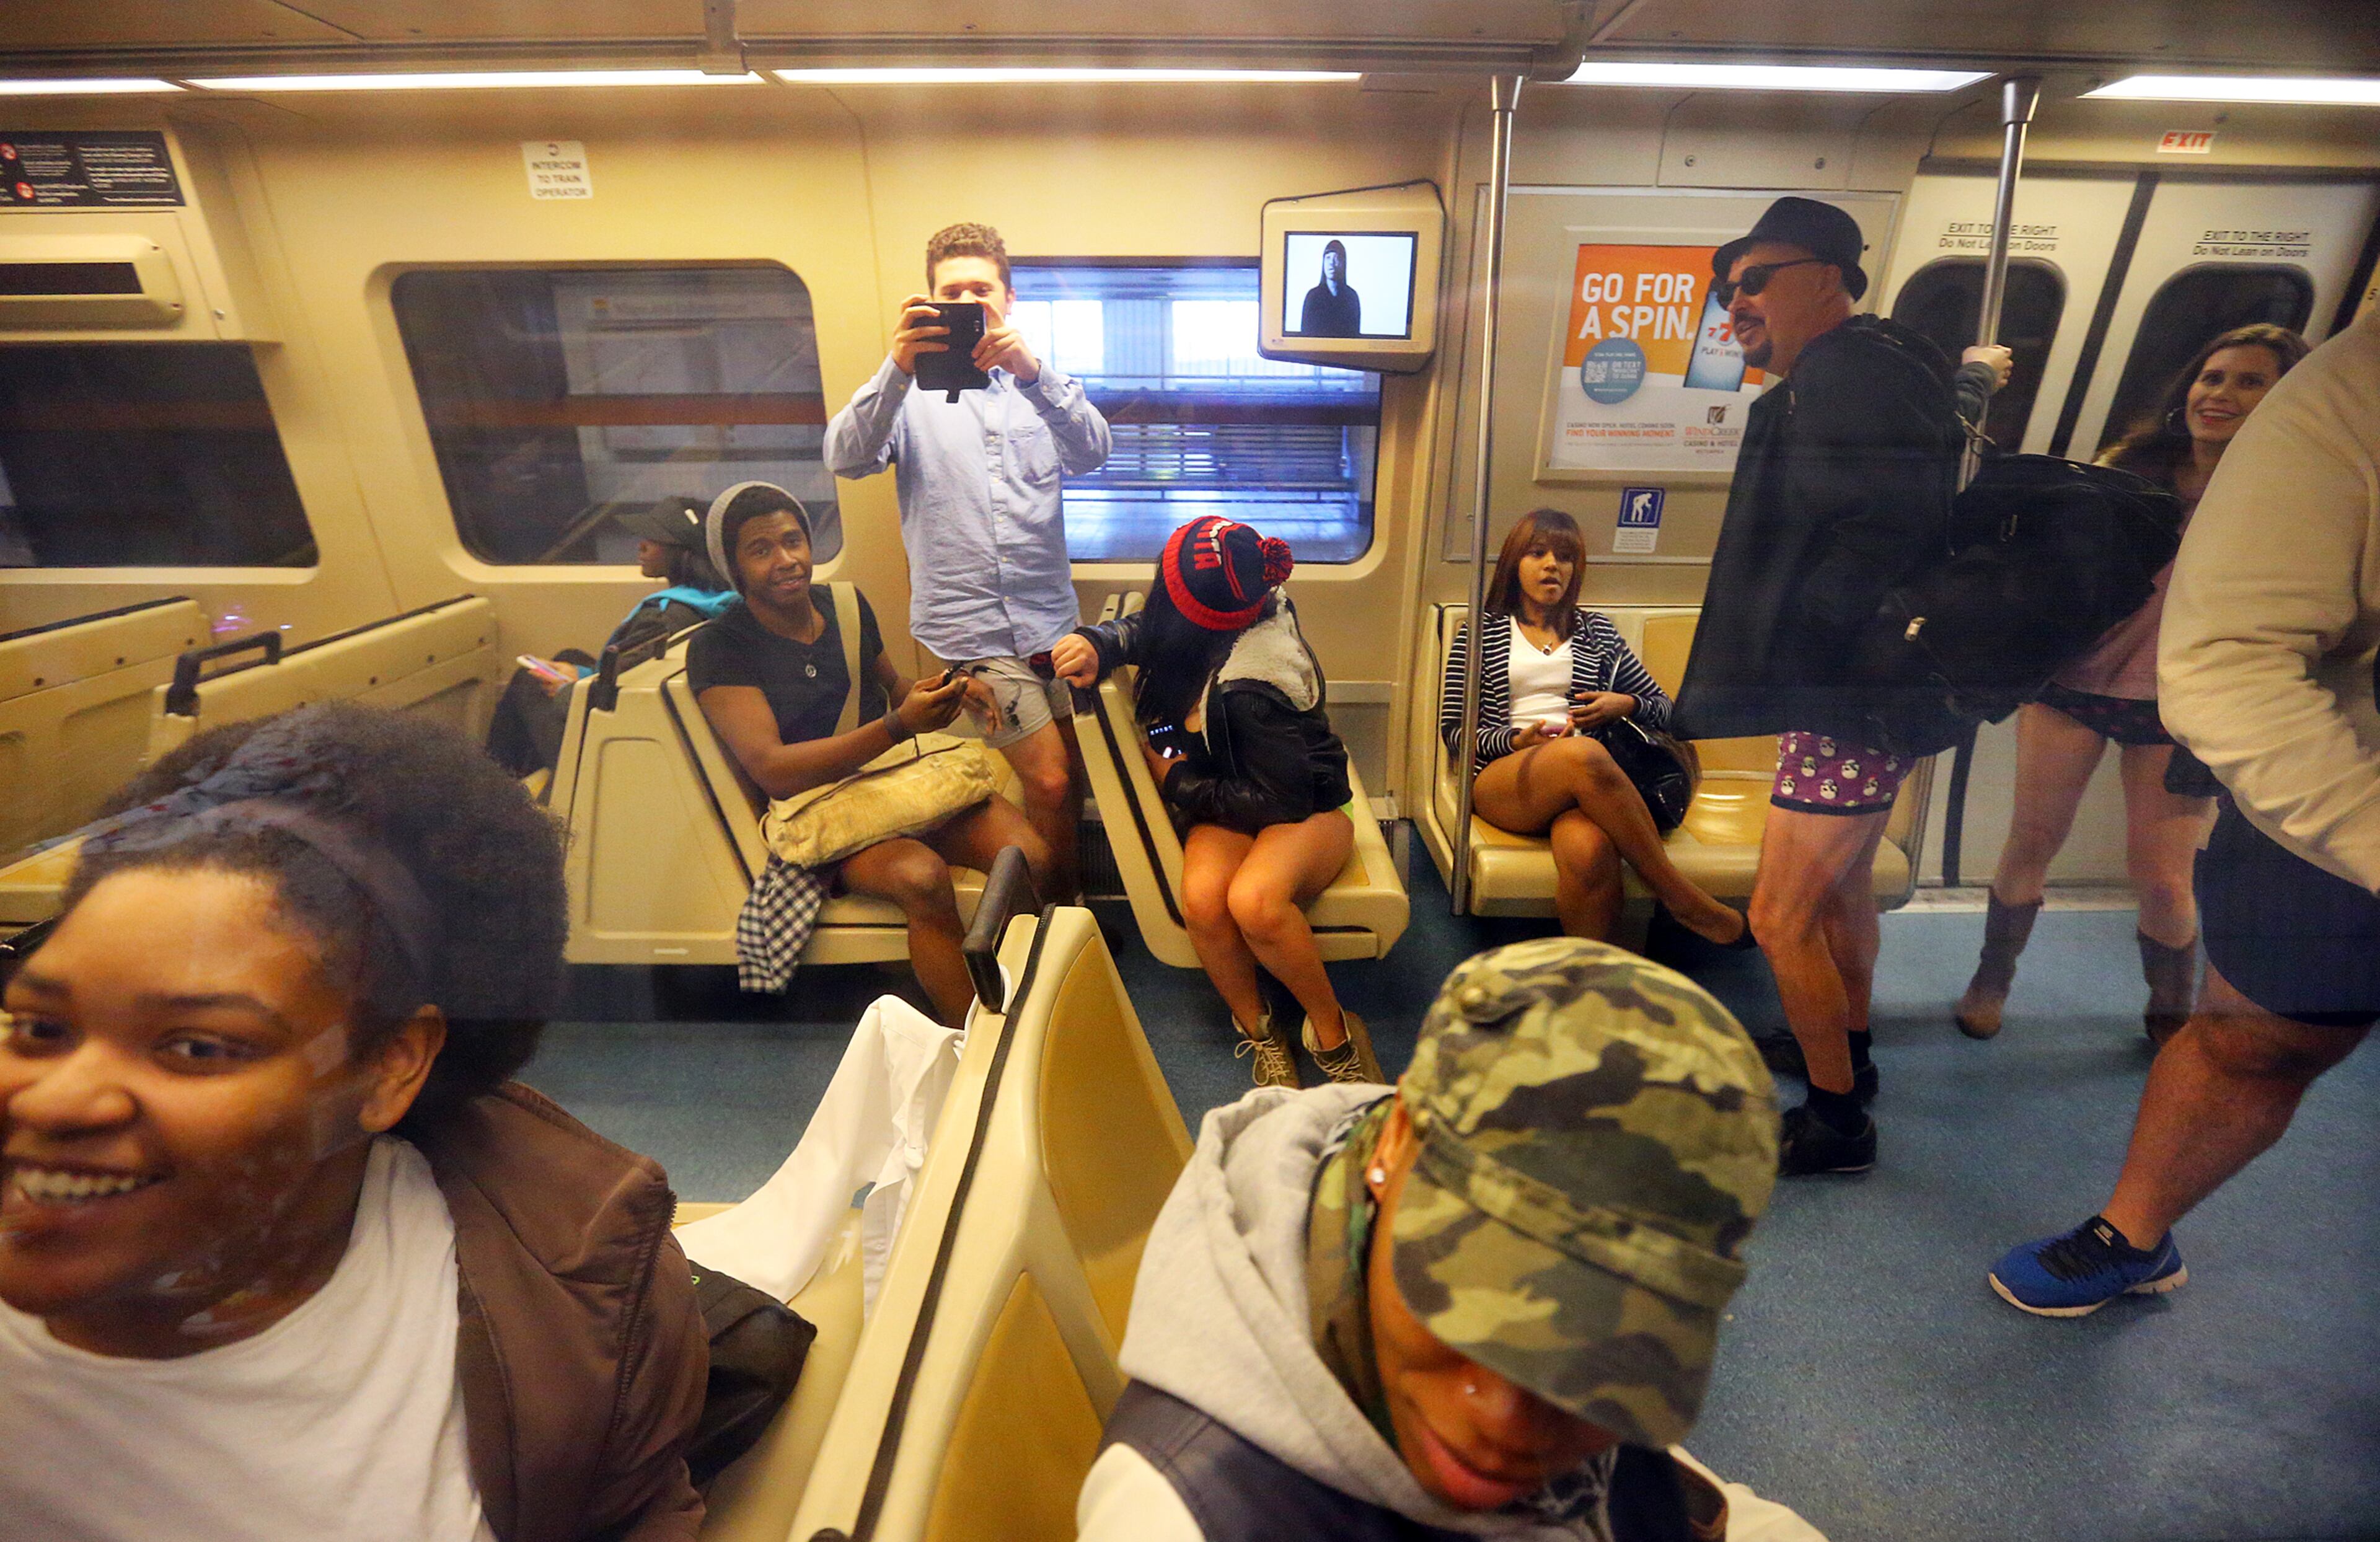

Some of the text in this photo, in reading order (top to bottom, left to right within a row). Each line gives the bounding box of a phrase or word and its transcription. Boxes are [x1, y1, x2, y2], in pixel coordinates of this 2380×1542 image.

[2162, 132, 2212, 147] EXIT
[532, 161, 581, 170] INTERCOM
[537, 174, 582, 183] TO TRAIN
[536, 188, 587, 196] OPERATOR
[1949, 223, 1974, 233] EXIT
[1978, 224, 1993, 234] TO
[2021, 225, 2056, 236] RIGHT
[2203, 231, 2310, 242] EXIT TO THE RIGHT
[1939, 237, 1954, 248] Do
[1957, 238, 1976, 249] Not
[2025, 240, 2056, 251] Doors
[2193, 245, 2208, 255] Do
[2211, 246, 2231, 256] Not
[2231, 247, 2259, 256] Lean
[2276, 247, 2309, 257] Doors
[1581, 273, 1696, 303] GO FOR
[1578, 306, 1694, 340] A SPIN.
[1701, 346, 1719, 355] PLAY
[1566, 429, 1584, 437] FIND
[1585, 429, 1607, 437] YOUR
